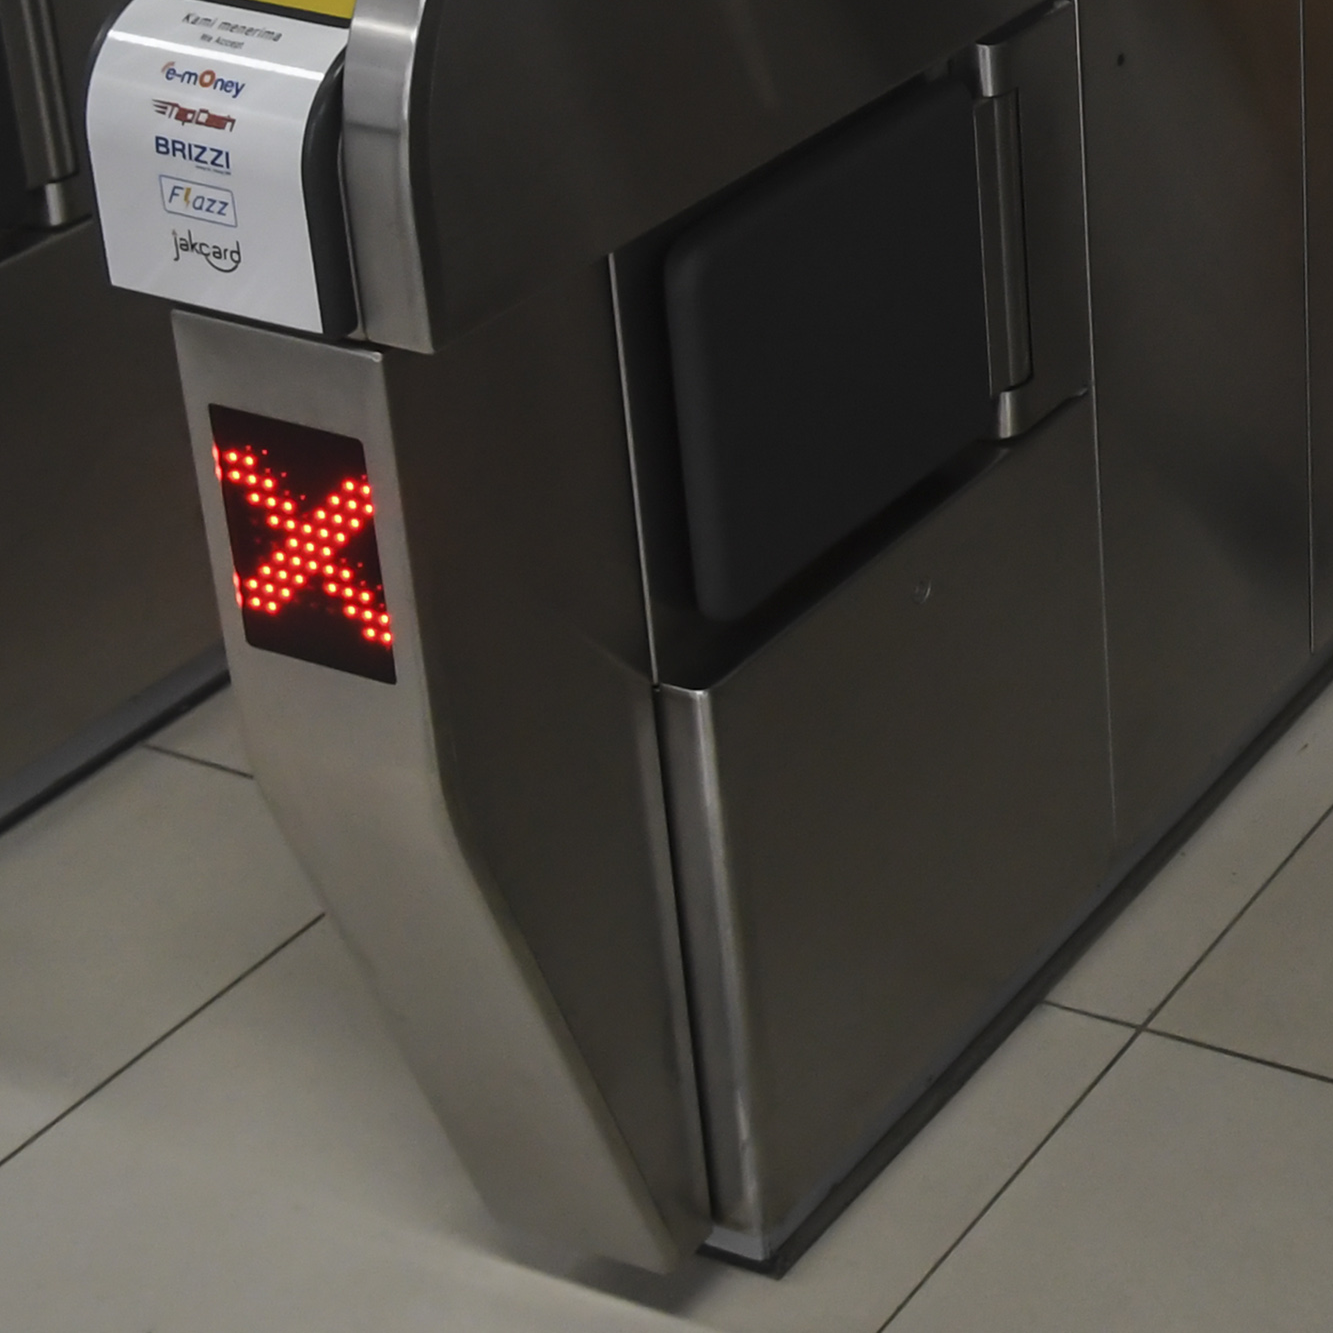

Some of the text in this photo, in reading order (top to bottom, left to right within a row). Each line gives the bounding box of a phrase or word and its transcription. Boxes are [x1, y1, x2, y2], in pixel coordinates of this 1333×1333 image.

[182, 12, 282, 43] Kami menerima
[155, 136, 231, 170] BRIZZI
[172, 229, 241, 273] jakcard
